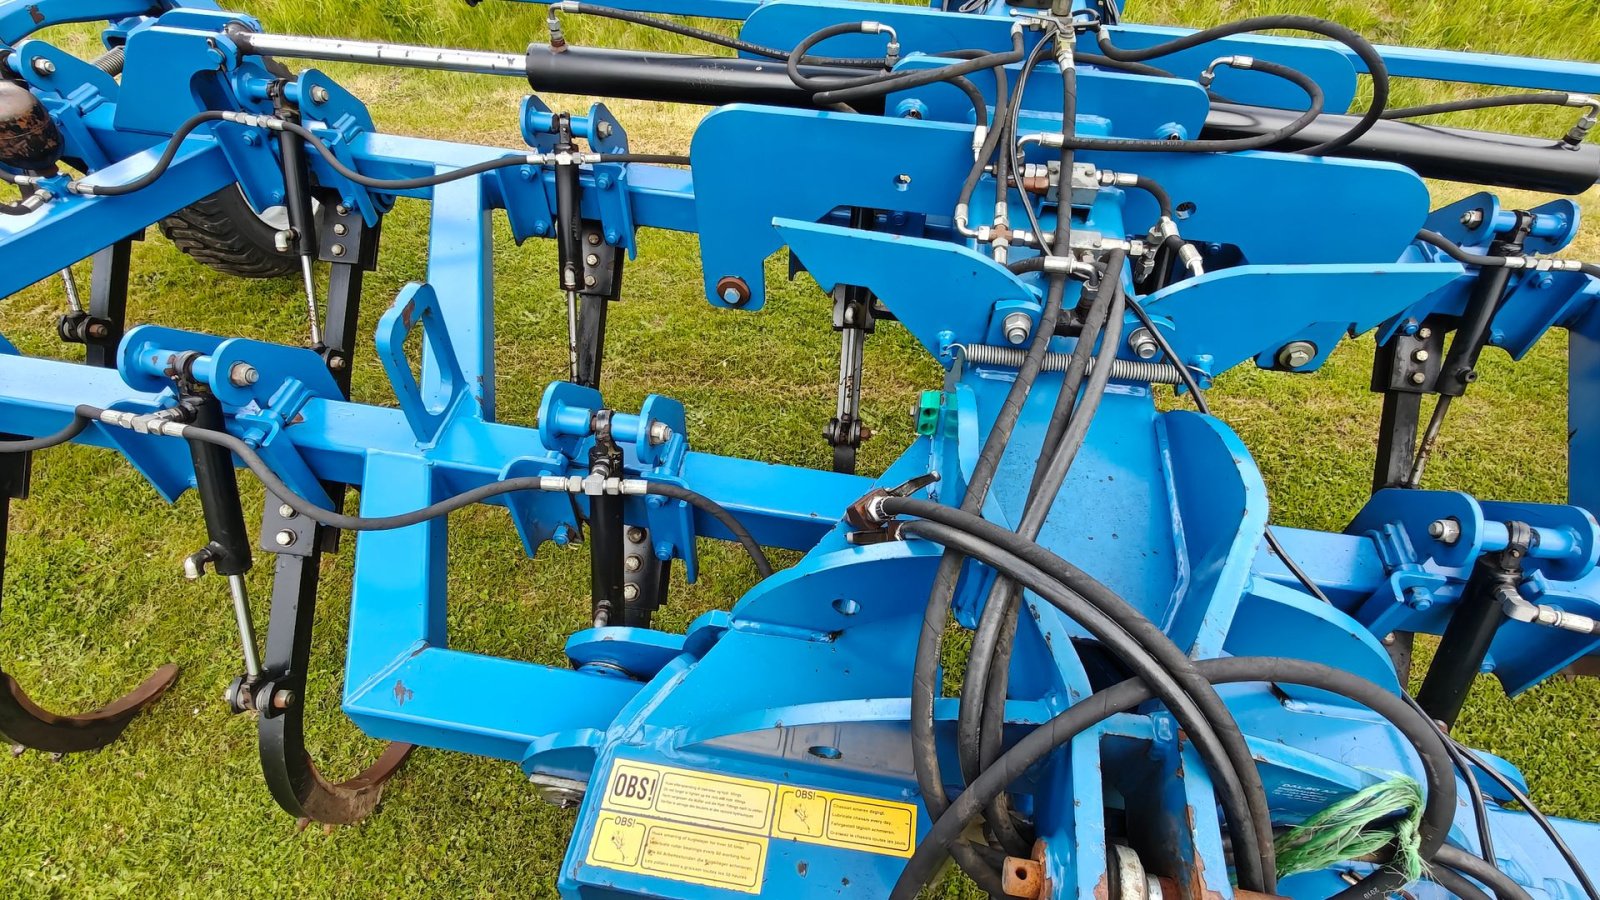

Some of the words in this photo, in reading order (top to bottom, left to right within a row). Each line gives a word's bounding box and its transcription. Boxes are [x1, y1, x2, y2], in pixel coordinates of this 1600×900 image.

[614, 773, 656, 802] OBS!
[795, 790, 816, 800] OBS!
[614, 815, 636, 828] OBS!
